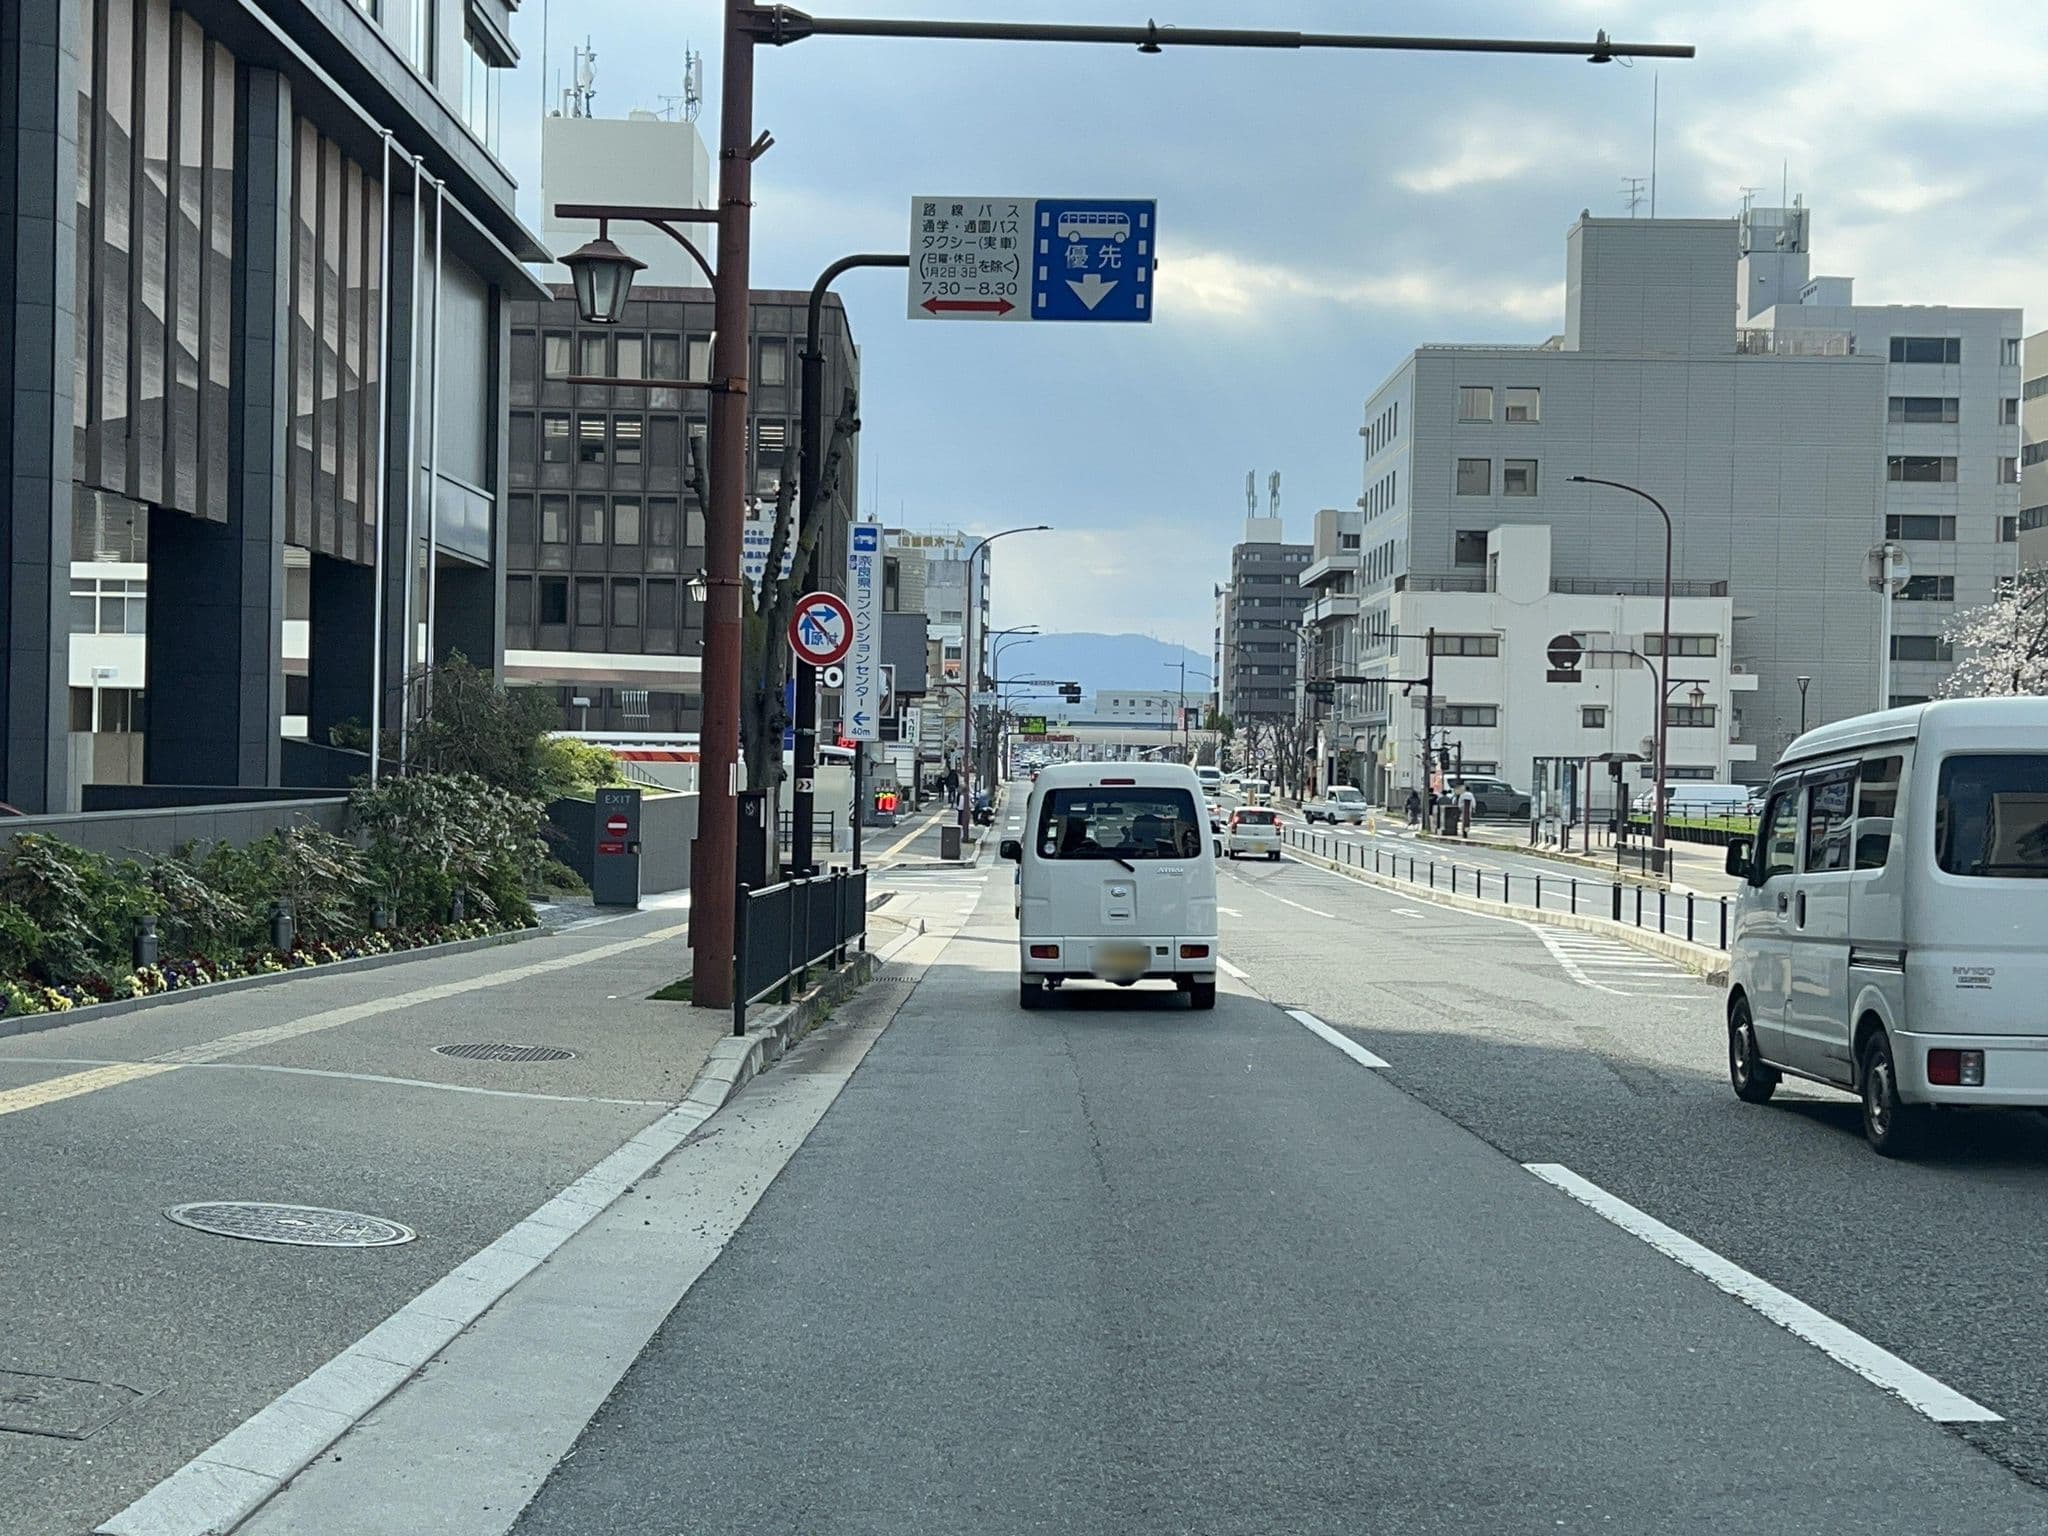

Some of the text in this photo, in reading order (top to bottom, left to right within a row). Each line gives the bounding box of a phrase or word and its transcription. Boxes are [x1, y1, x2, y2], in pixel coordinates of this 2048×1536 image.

[1064, 244, 1122, 269] 優先
[856, 555, 873, 707] 奈良県コンベンションセンター
[851, 727, 871, 736] 40m
[604, 794, 632, 804] EXIT
